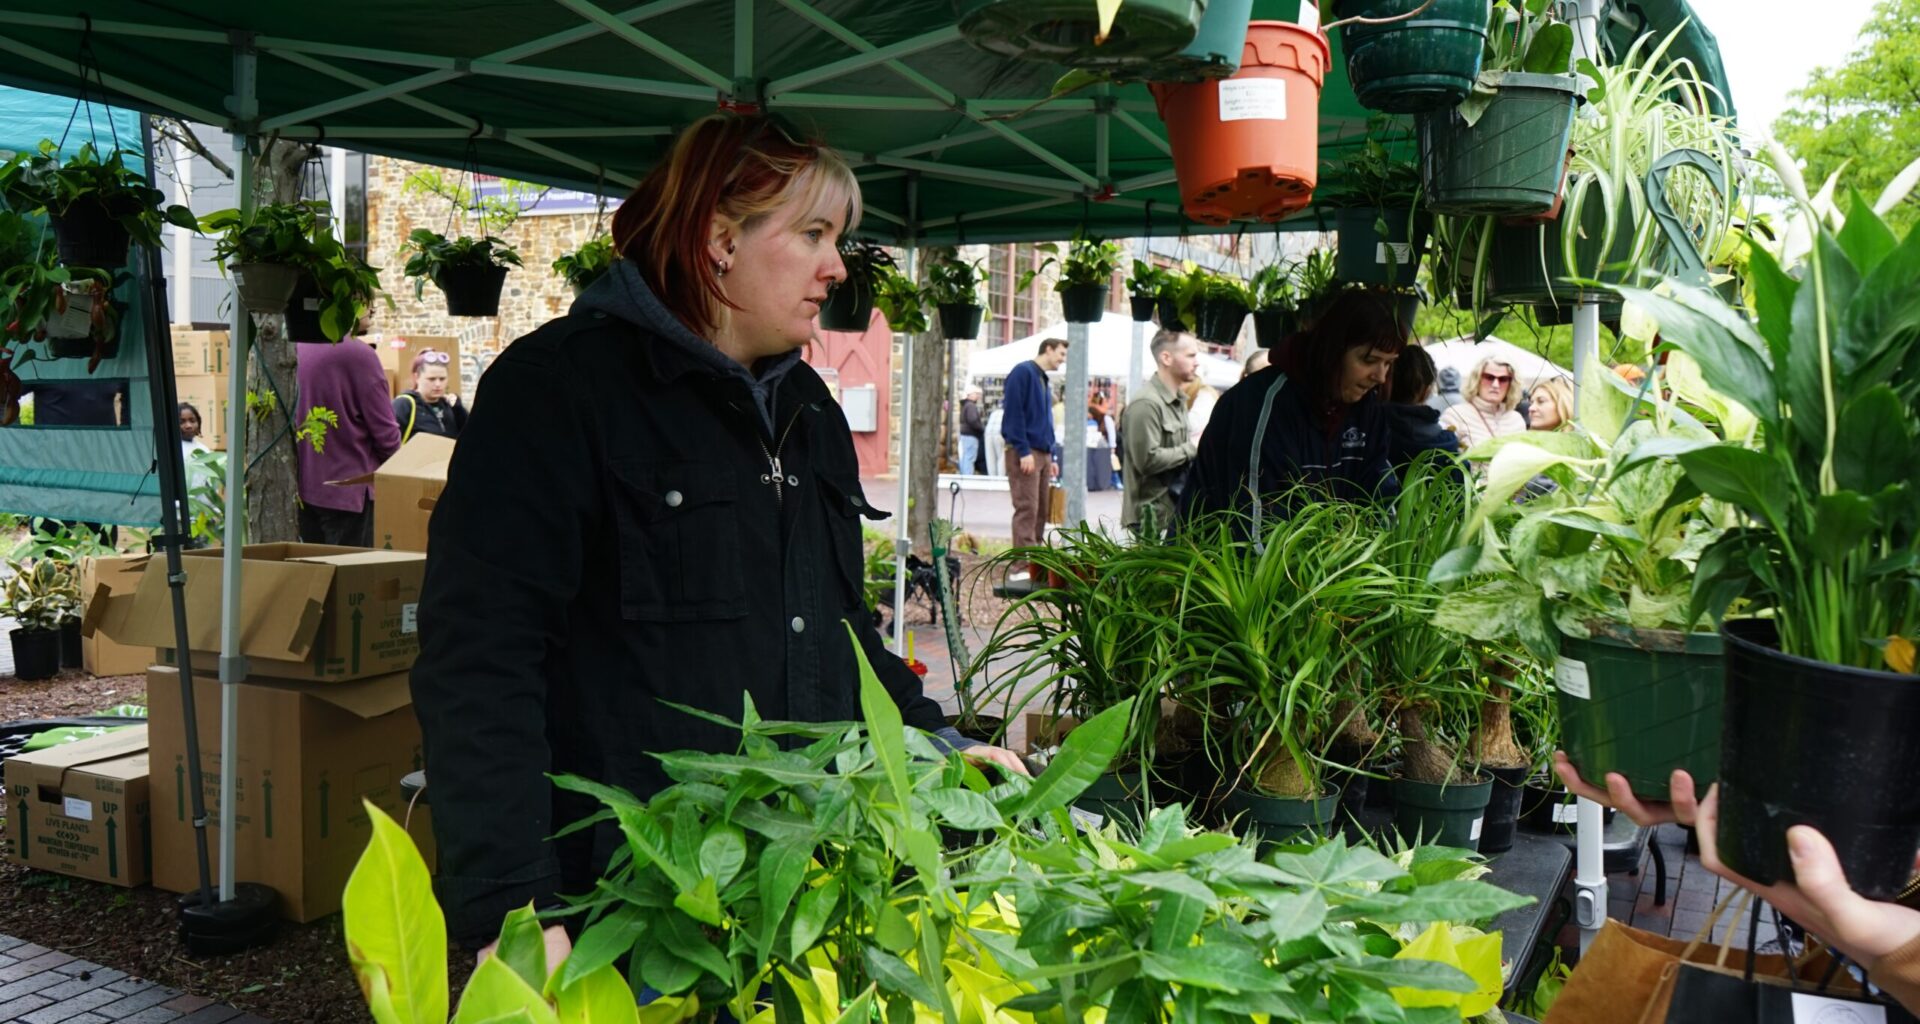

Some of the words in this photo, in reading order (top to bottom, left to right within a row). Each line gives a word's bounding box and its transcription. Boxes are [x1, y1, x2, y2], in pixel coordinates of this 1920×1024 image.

[348, 592, 365, 606] UP
[14, 784, 30, 797] UP
[102, 801, 118, 815] UP
[45, 817, 60, 828] LIVE
[62, 820, 90, 834] PLANTS
